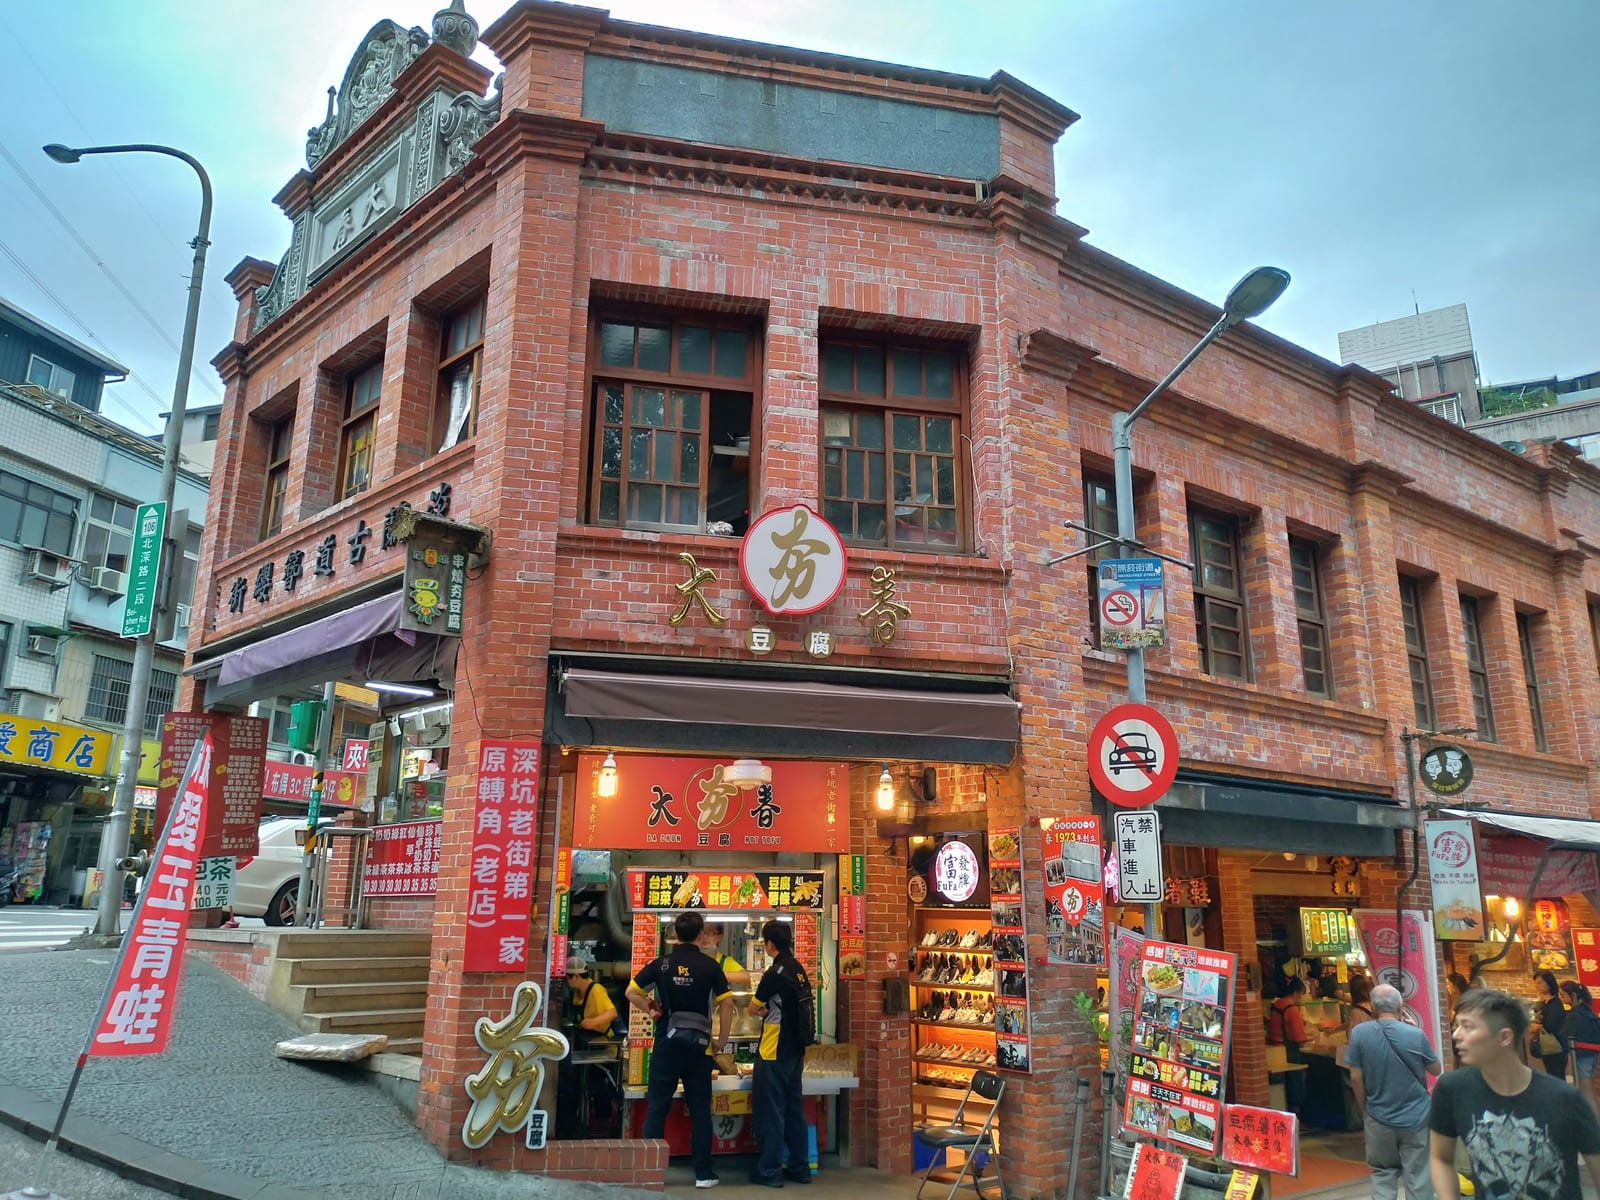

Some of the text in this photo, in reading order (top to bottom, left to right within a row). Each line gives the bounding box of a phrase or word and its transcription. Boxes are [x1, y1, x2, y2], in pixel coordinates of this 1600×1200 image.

[144, 522, 156, 533] 106
[135, 538, 152, 605] 北深路二段
[289, 777, 302, 794] 3C
[303, 776, 337, 800] 精公仔
[697, 832, 731, 846] 豆腐
[498, 747, 537, 964] 深坑老街第一家
[1121, 817, 1140, 895] 汽車進入
[216, 884, 228, 895] 元
[386, 880, 394, 892] 30
[394, 880, 402, 892] 30
[402, 879, 410, 892] 30
[410, 879, 419, 891] 35
[420, 879, 428, 891] 35
[649, 875, 672, 890] 台式
[708, 876, 730, 890] 豆腐
[769, 876, 791, 890] 豆腐
[937, 880, 957, 891] FuFa
[215, 896, 228, 906] 元
[648, 891, 671, 905] 泡菜
[1146, 946, 1164, 959] 感謝
[1132, 1080, 1150, 1095] 感謝
[529, 1112, 546, 1149] 豆腐
